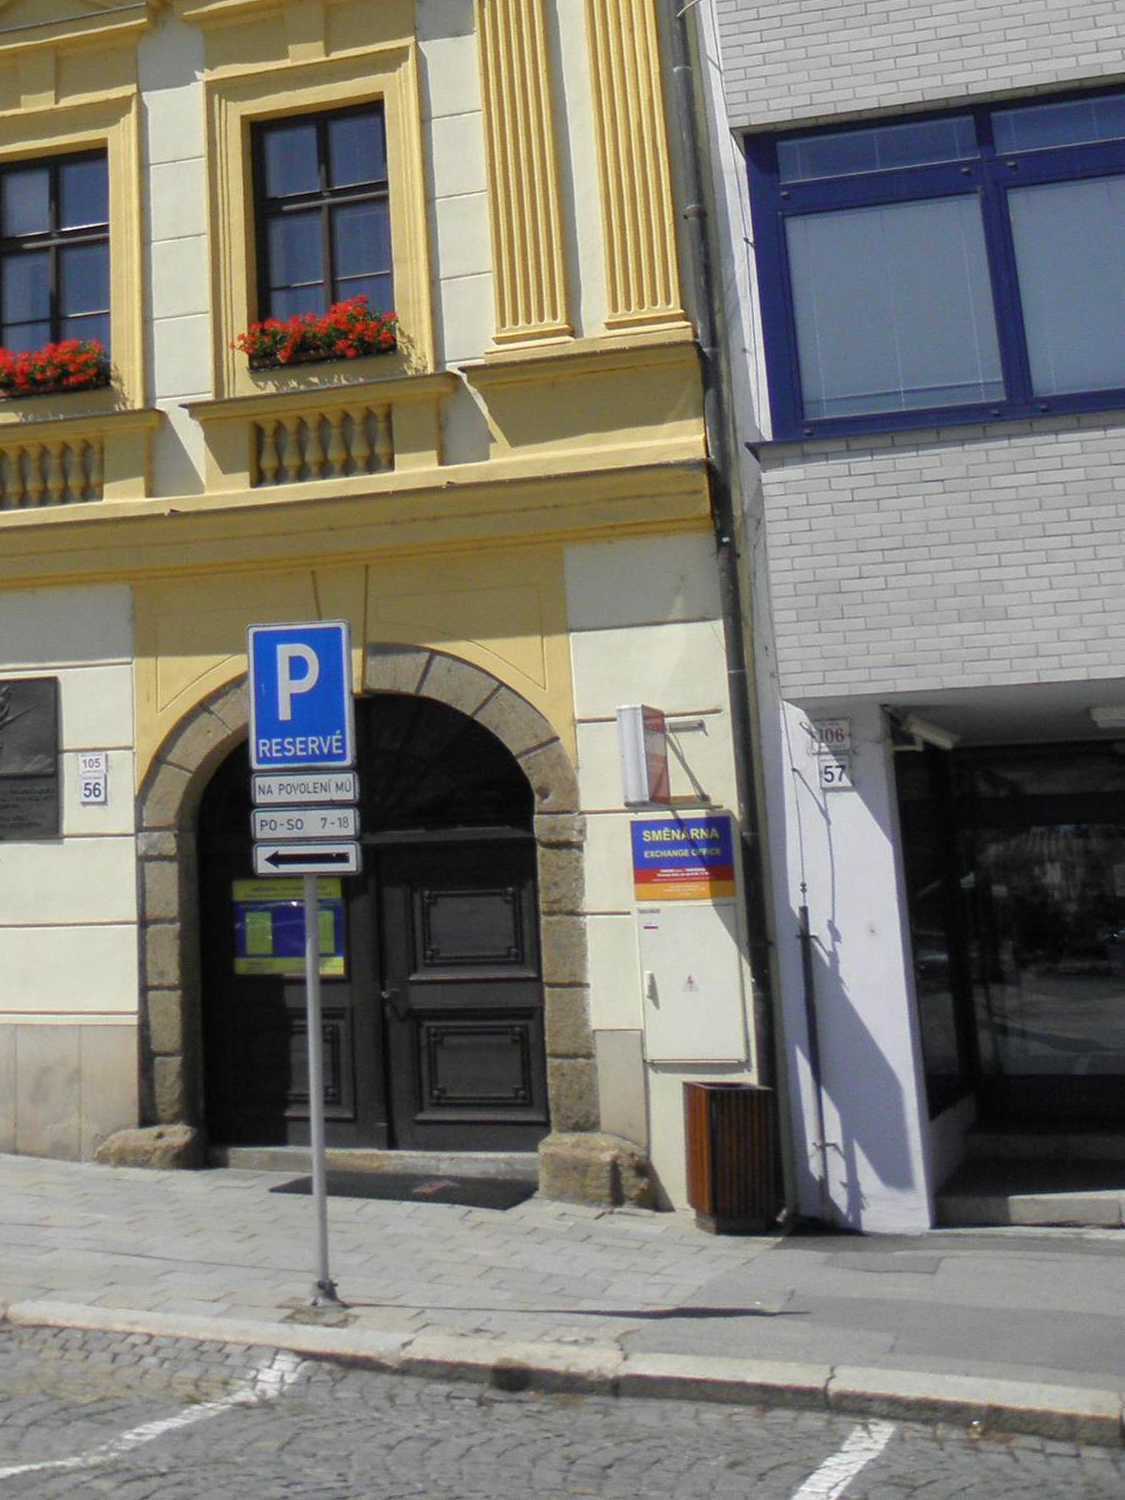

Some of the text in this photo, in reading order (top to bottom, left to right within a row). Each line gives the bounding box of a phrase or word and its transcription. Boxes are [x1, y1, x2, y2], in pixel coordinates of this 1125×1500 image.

[276, 643, 320, 721] P
[258, 730, 343, 757] RESERVÉ
[82, 758, 101, 768] 105
[824, 764, 846, 783] 57
[83, 782, 102, 798] 56
[258, 779, 352, 795] NA POVOLENÍ MÚ
[644, 849, 690, 859] EXCHANGE
